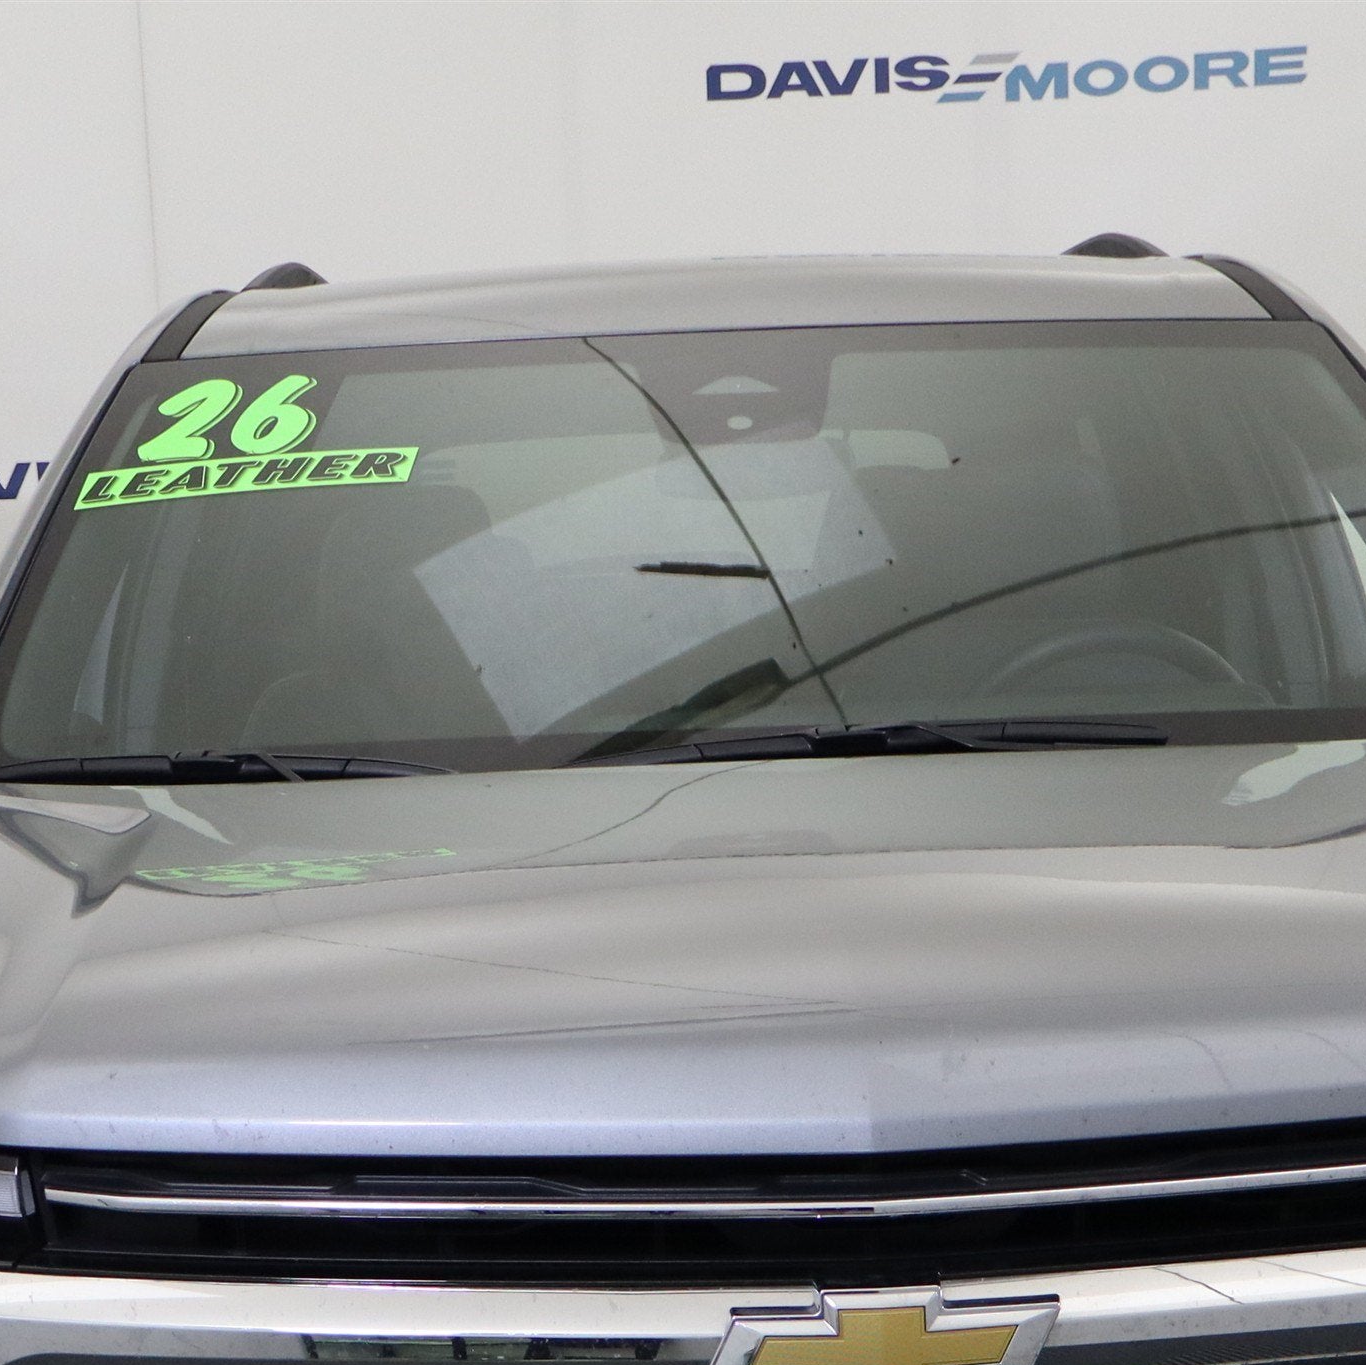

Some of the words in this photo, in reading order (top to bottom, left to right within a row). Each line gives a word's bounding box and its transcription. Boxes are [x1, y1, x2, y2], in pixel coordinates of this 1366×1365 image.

[706, 54, 950, 101] DAVIS
[1005, 45, 1308, 102] MOORE
[137, 374, 317, 462] 26
[81, 449, 405, 504] LEATHER
